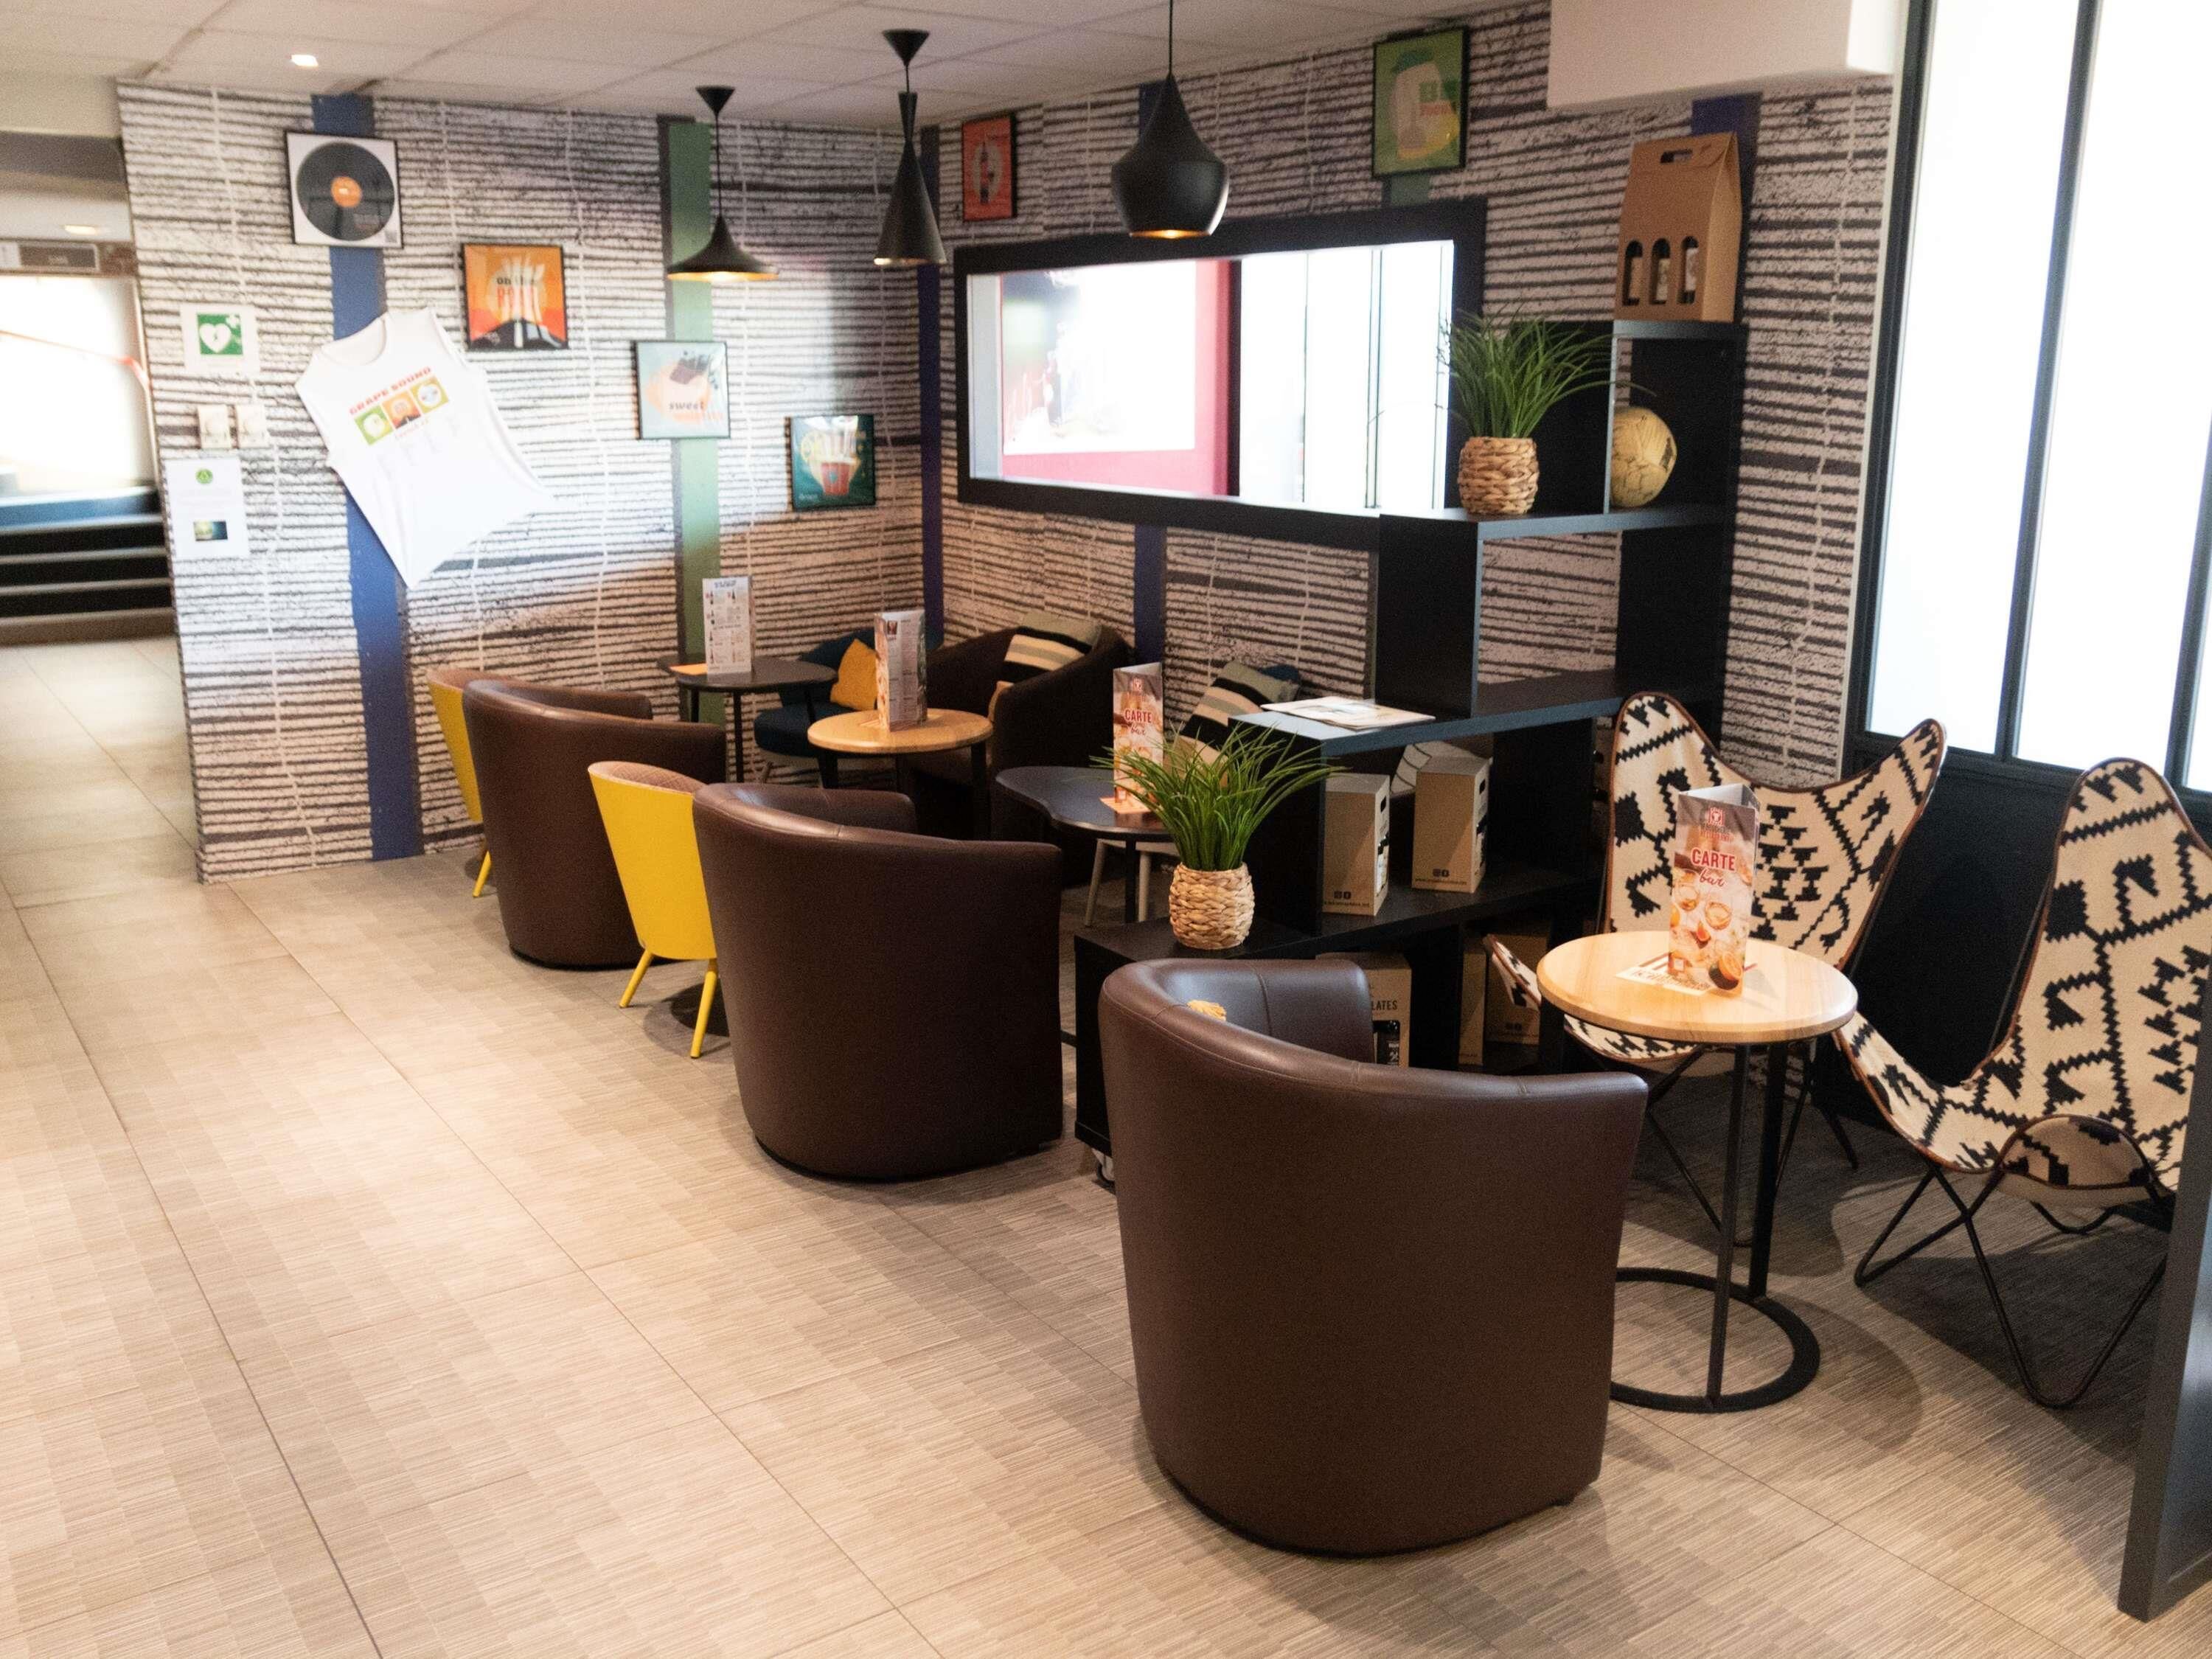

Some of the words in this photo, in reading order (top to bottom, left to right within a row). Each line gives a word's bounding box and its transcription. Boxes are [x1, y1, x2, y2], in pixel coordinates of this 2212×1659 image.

[349, 389, 389, 414] GRAPE
[391, 366, 431, 391] SOUND
[669, 400, 705, 410] sweet
[1124, 709, 1152, 723] CARTE
[1691, 848, 1736, 872] CARTE
[1699, 869, 1725, 887] bar
